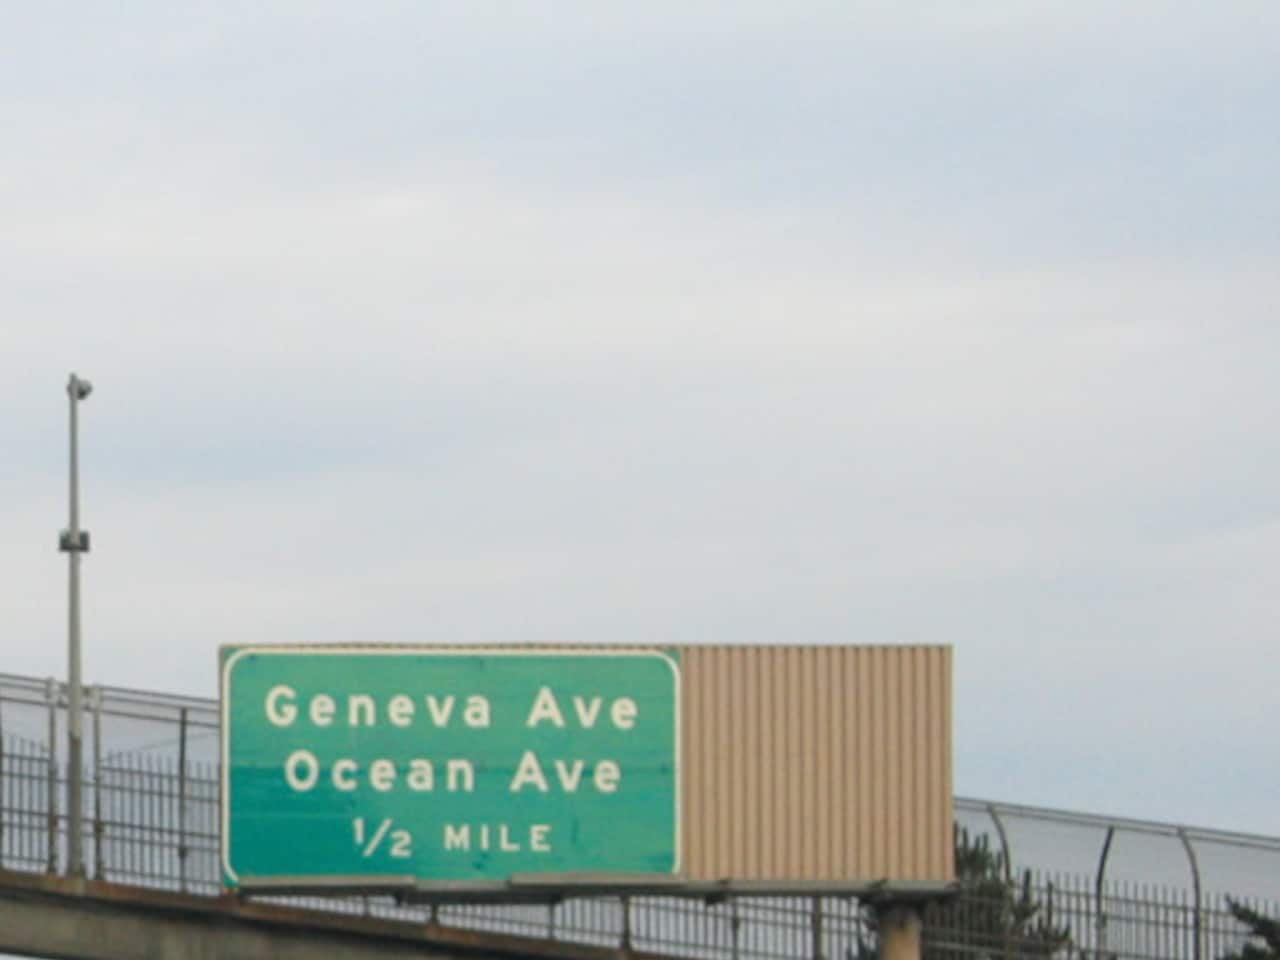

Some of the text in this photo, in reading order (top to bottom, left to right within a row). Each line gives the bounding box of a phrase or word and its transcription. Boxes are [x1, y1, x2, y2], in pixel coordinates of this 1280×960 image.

[265, 684, 639, 729] Geneva Ave
[284, 750, 621, 793] Ocean Ave
[444, 825, 551, 852] MILE
